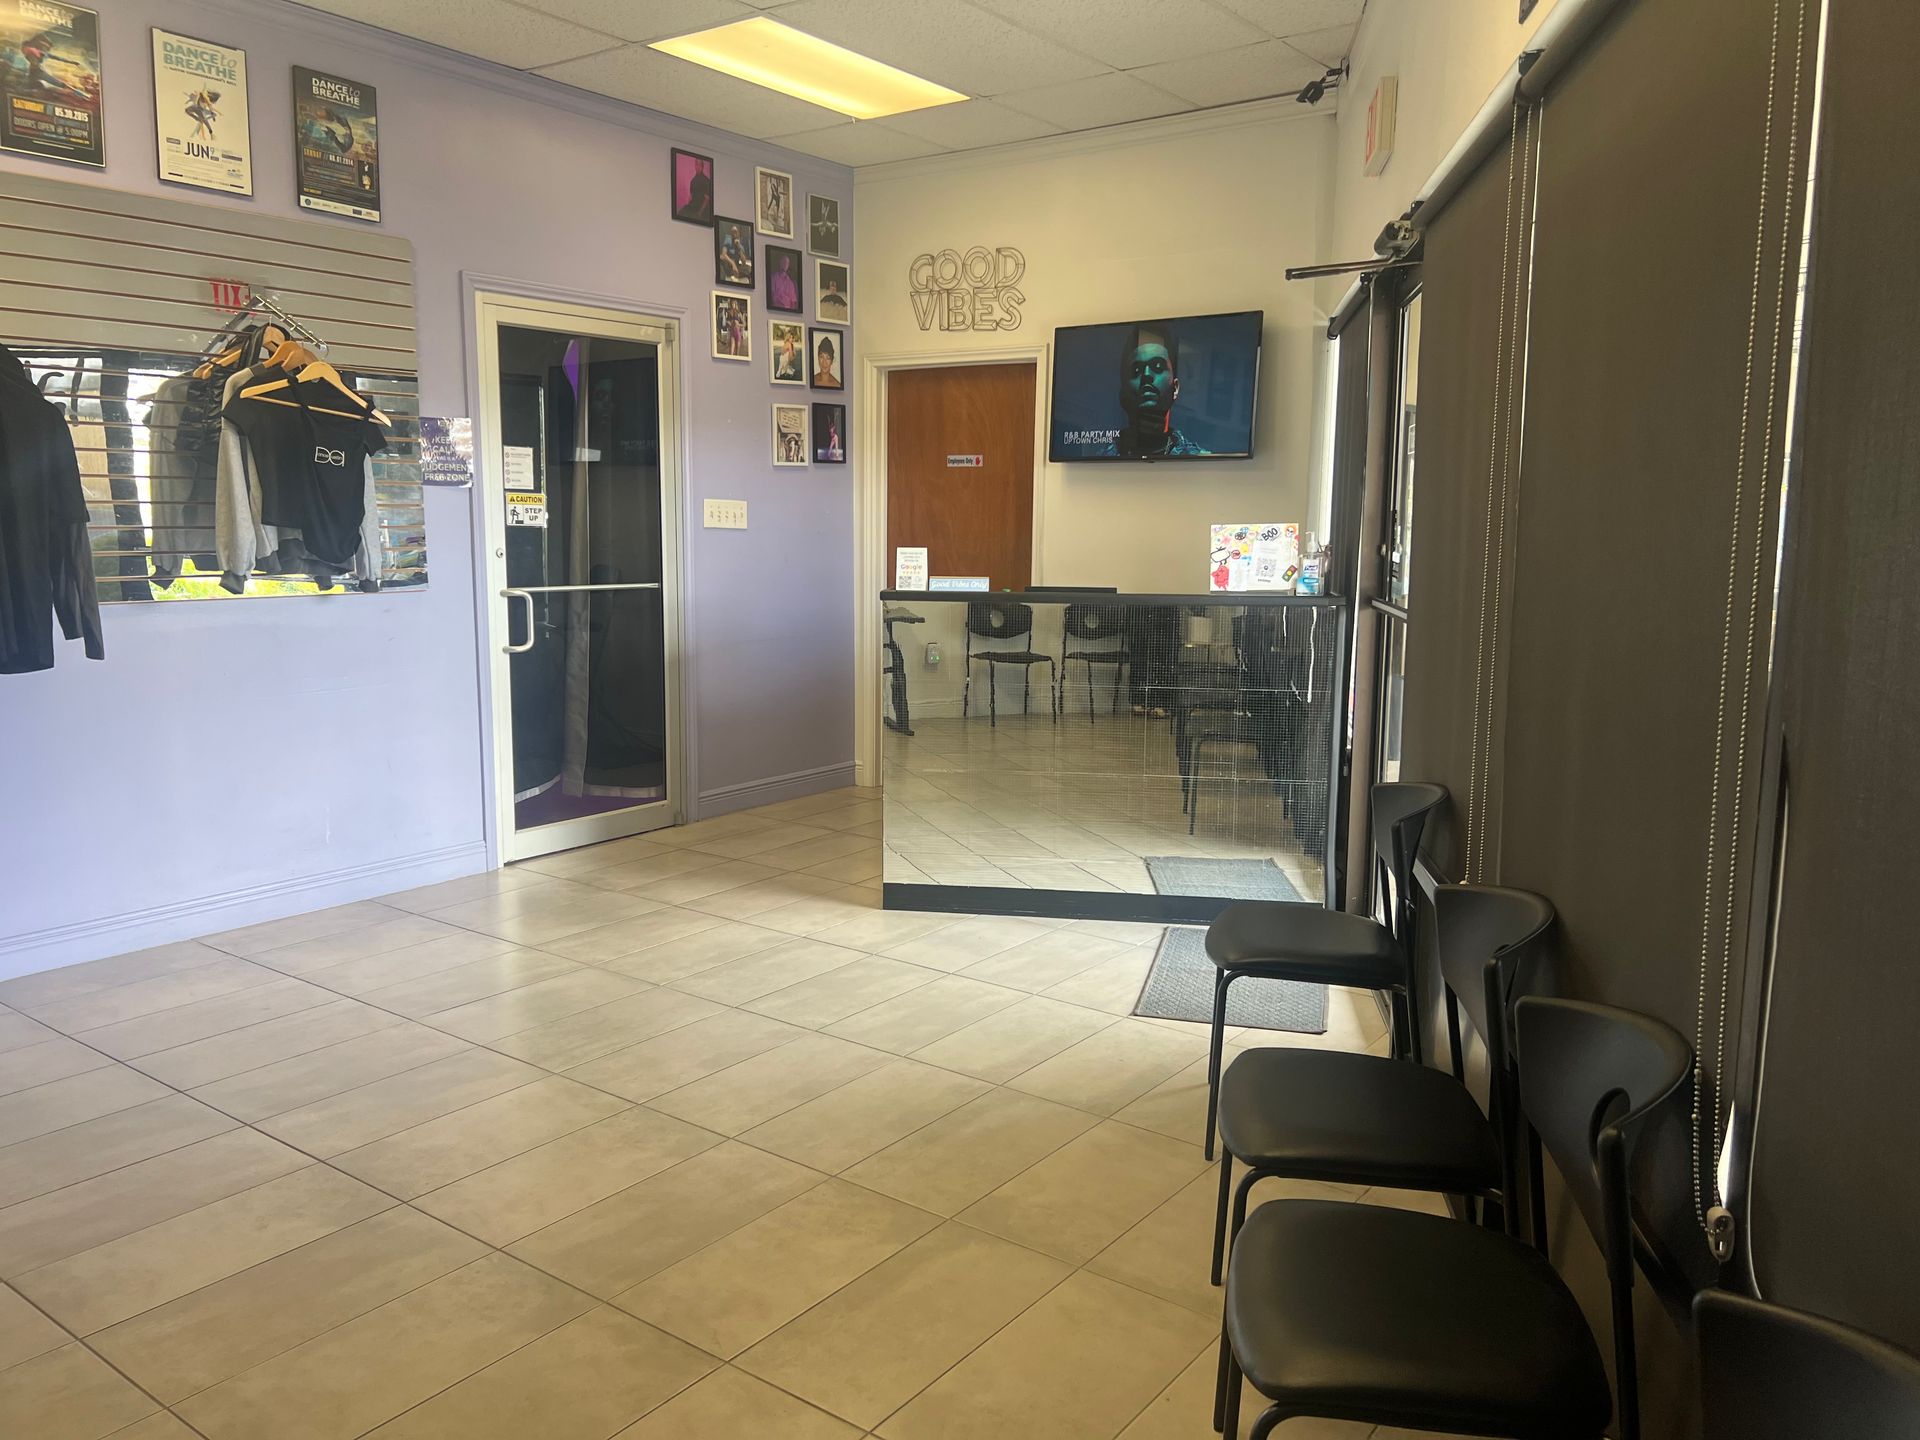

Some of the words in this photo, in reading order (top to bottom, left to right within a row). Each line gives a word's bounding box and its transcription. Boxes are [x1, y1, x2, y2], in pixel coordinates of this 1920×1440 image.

[19, 0, 59, 18] DANCE
[162, 41, 219, 65] DANCE
[220, 54, 238, 69] to
[163, 54, 237, 81] BREATHE
[312, 77, 348, 95] DANCE
[349, 86, 361, 98] to
[312, 85, 360, 106] BREATHE
[184, 142, 210, 160] JUN
[909, 246, 1026, 293] GOOD
[909, 286, 1026, 332] VIBES
[1063, 436, 1091, 445] UPTOWN
[1093, 436, 1113, 444] CHRIS
[1064, 431, 1079, 439] R&B
[1081, 430, 1104, 439] PARTY
[1106, 429, 1120, 438] MIX
[421, 463, 471, 472] JUDGEMEN
[515, 495, 543, 504] CAUTION
[524, 507, 543, 515] STEP
[1260, 526, 1279, 542] BOO
[900, 563, 922, 571] Google
[931, 580, 950, 589] Good
[970, 580, 988, 589] Only
